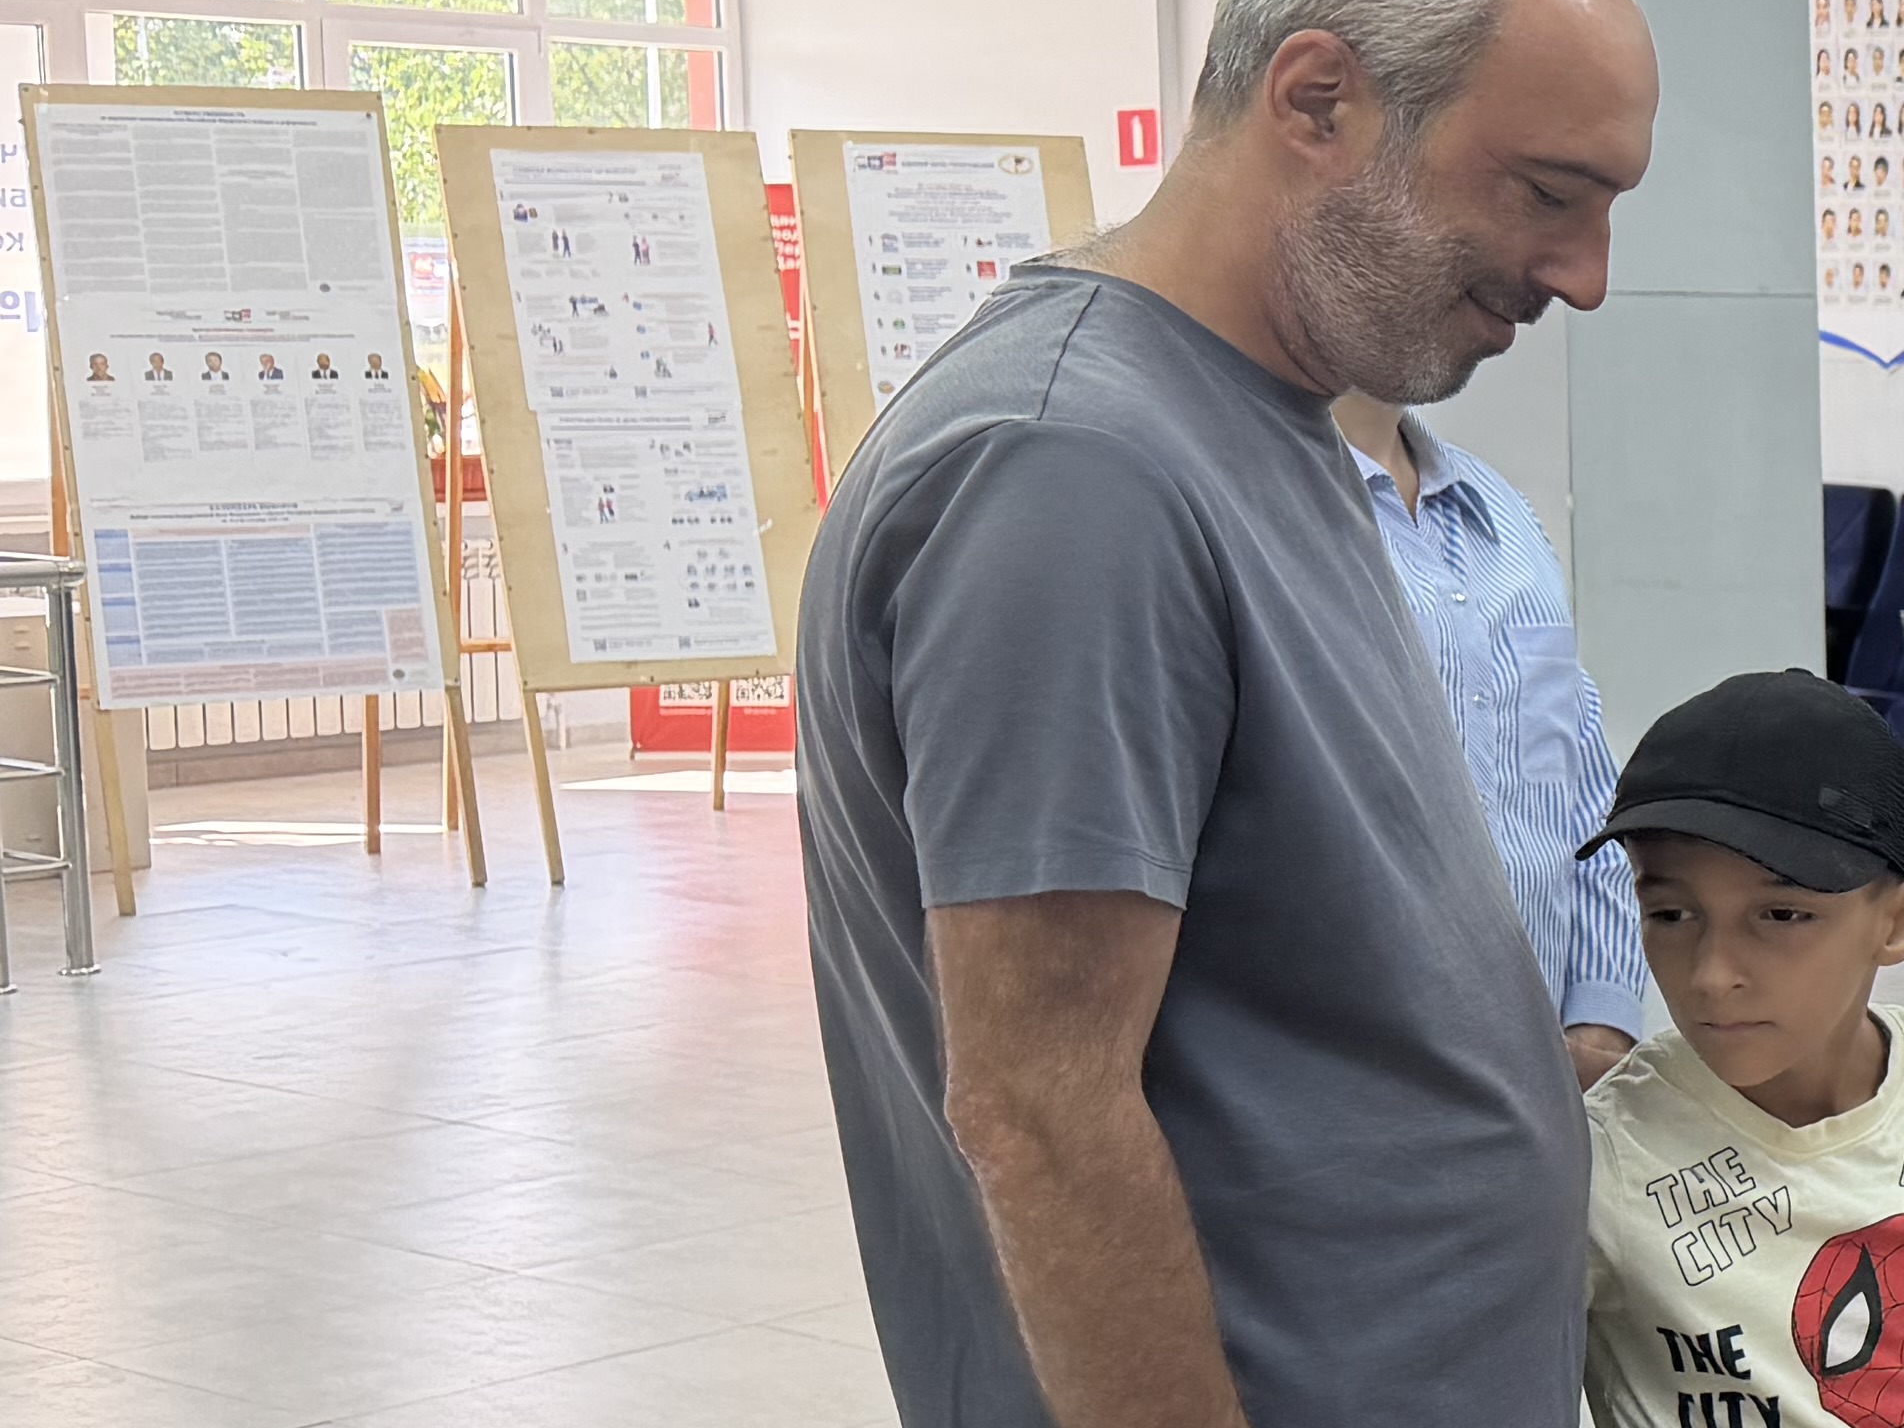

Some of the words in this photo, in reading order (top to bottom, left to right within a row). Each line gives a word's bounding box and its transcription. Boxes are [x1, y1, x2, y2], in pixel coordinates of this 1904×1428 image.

[1646, 1146, 1757, 1229] THE
[1671, 1185, 1793, 1287] CITY
[1656, 1324, 1752, 1380] THE
